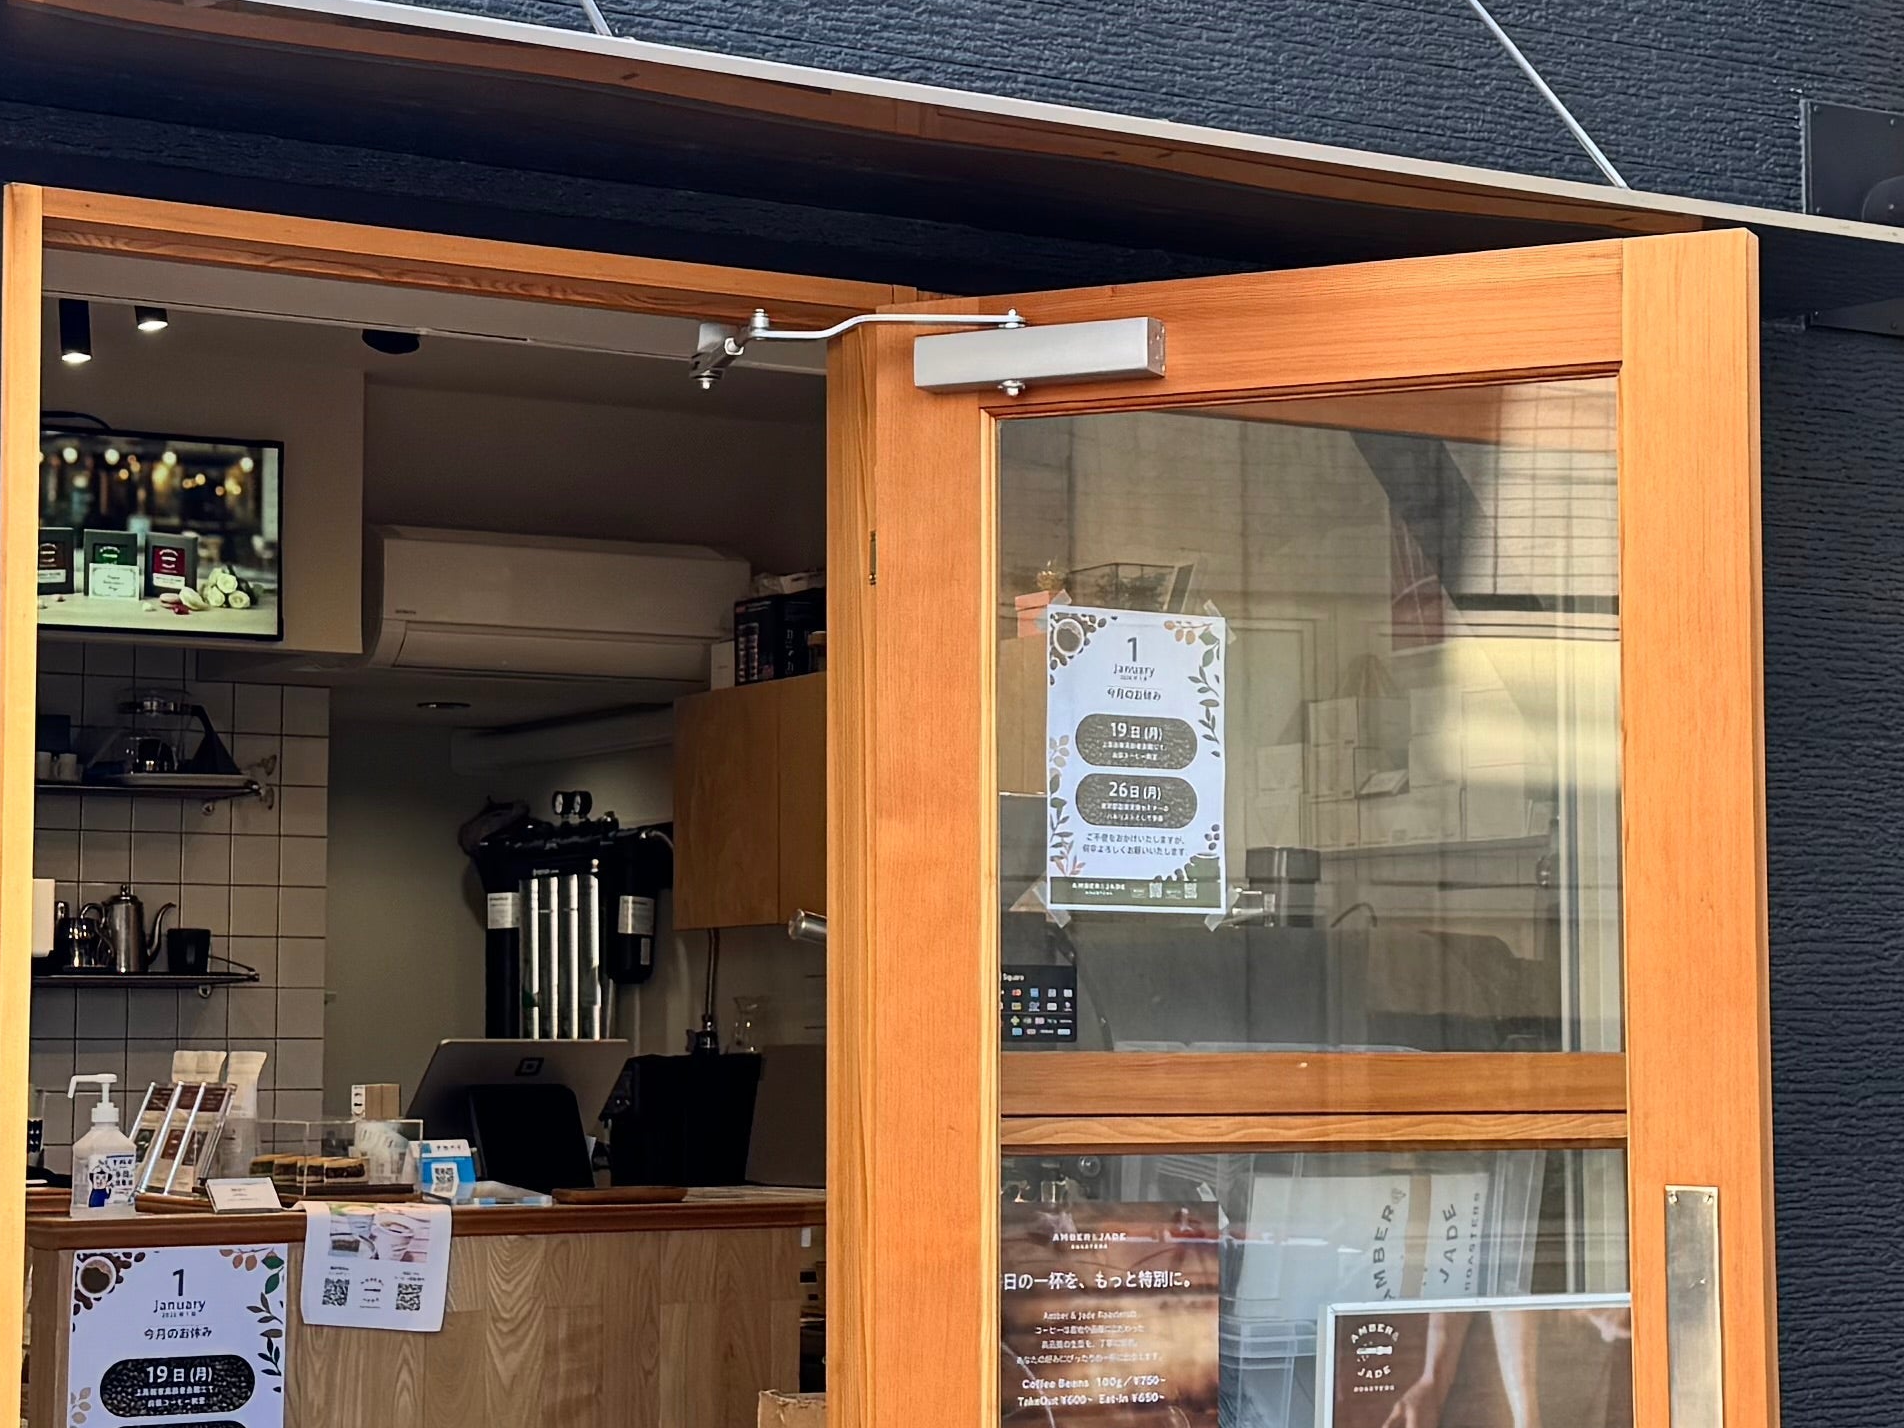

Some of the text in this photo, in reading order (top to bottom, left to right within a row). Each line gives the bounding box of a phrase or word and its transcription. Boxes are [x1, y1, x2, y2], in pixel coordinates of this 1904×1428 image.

[1127, 637, 1137, 662] 1
[1439, 1204, 1459, 1284] JADE
[172, 1268, 184, 1297] 1
[1003, 1270, 1191, 1291] 日の一杯を、もっと特別に。
[153, 1299, 206, 1313] January
[144, 1326, 213, 1341] 今月のお休み
[1351, 1323, 1394, 1344] AMBER
[1356, 1365, 1392, 1379] JADE
[1022, 1378, 1056, 1389] Coffee
[1058, 1377, 1090, 1389] Beans
